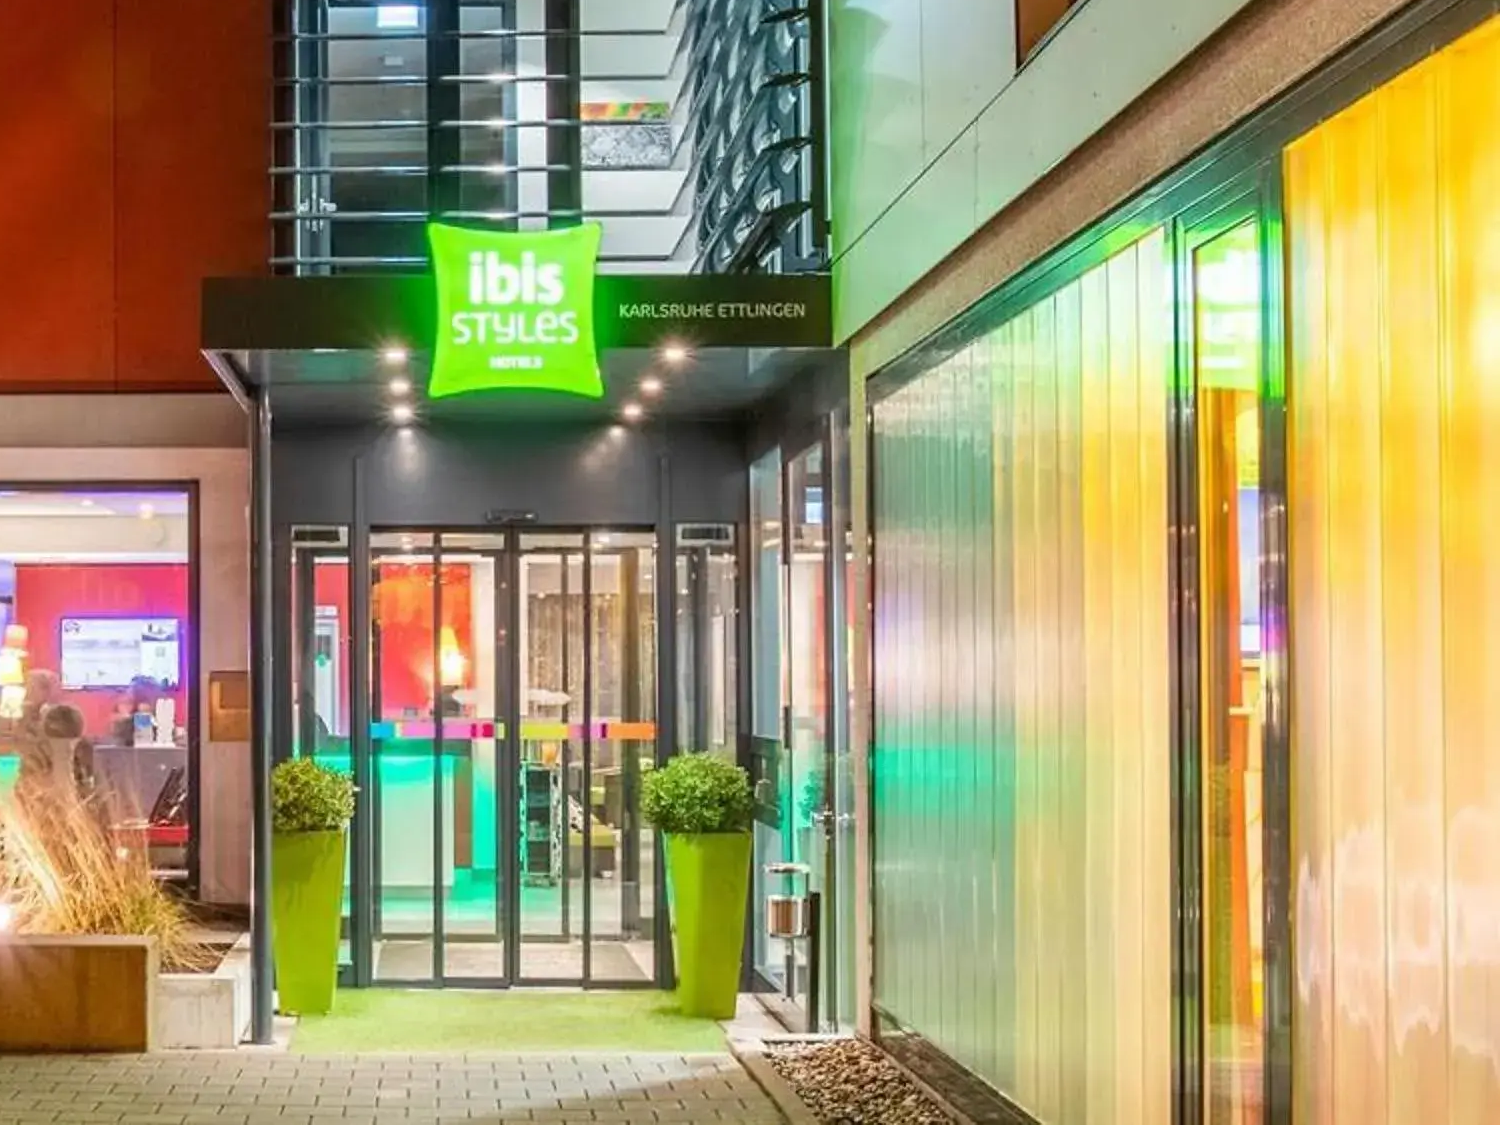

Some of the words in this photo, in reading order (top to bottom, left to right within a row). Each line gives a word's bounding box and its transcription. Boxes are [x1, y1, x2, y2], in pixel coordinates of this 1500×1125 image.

[469, 251, 564, 305] ibis
[618, 303, 714, 318] KARLSRUHE
[717, 302, 806, 318] ETTLINGEN
